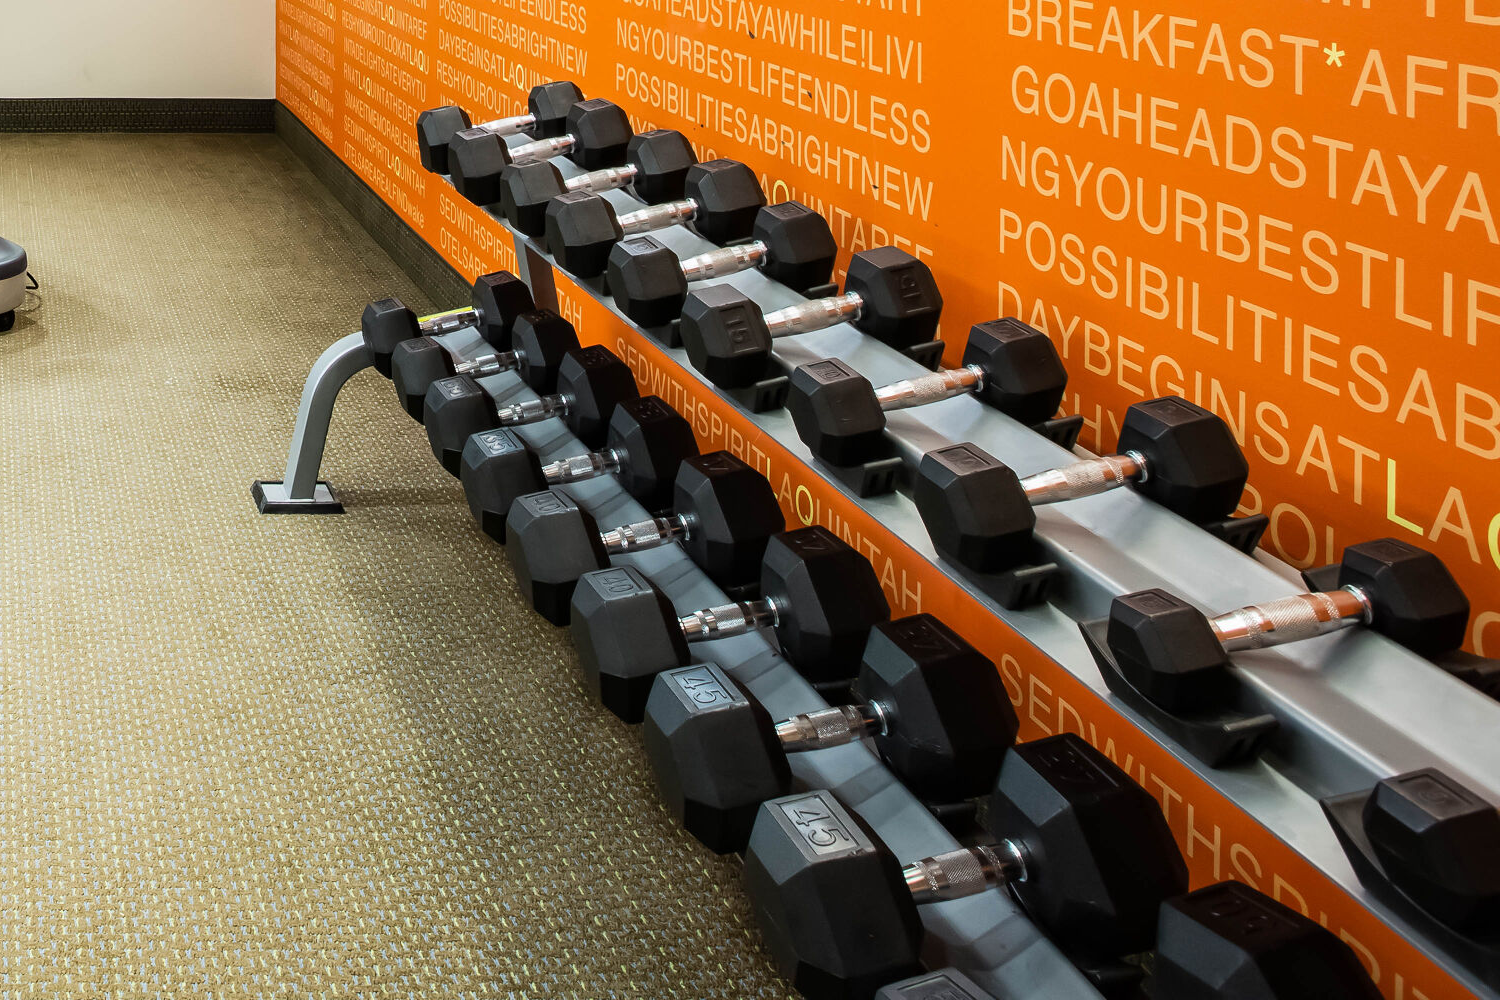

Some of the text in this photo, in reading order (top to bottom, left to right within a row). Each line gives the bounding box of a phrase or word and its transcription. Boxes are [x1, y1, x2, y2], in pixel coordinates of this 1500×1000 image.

[616, 63, 933, 222] POSSIBILITIESABRIGHTNEW
[617, 18, 931, 154] NGYOURBESTLIFEENDLESS
[998, 281, 1500, 572] DAYBEGINSATLA
[682, 676, 728, 704] 45
[793, 809, 850, 847] 45
